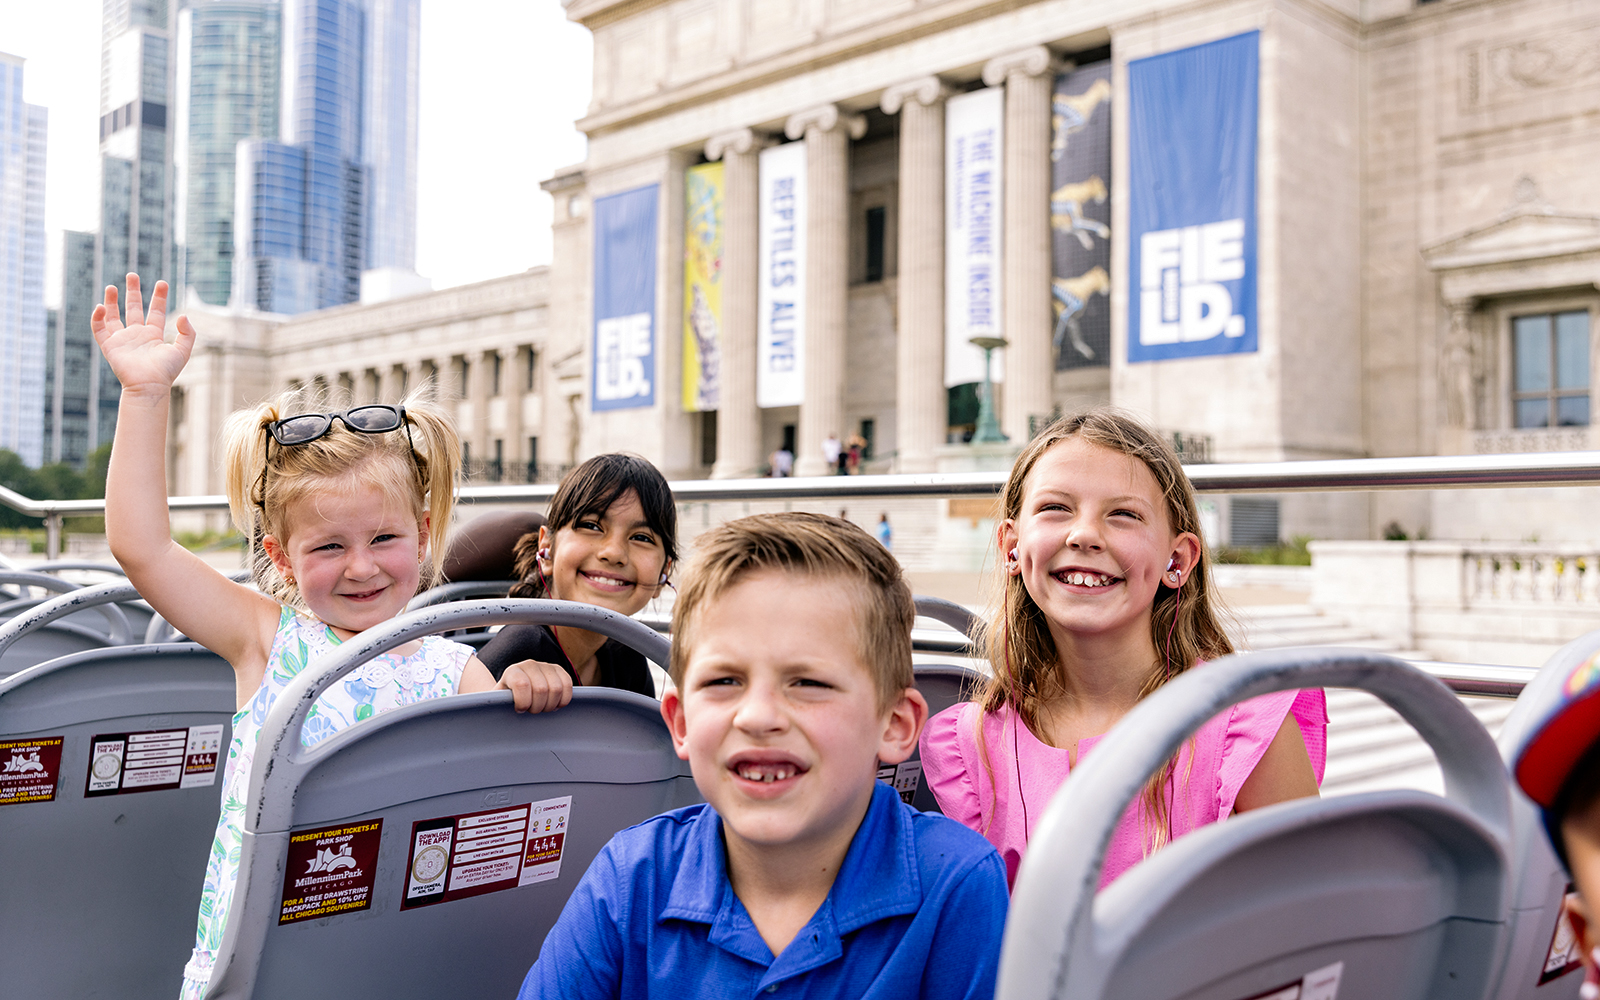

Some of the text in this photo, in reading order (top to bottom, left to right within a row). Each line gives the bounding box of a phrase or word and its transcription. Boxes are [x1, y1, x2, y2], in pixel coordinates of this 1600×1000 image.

[971, 127, 994, 161] THE
[771, 177, 795, 288] REPTILES
[18, 784, 53, 792] DRAWSTRING
[291, 832, 322, 843] PRESENT
[324, 829, 342, 837] YOUR
[343, 826, 370, 834] TICKETS
[316, 835, 353, 846] PARK SHOP
[419, 831, 450, 840] DOWNLOAD
[304, 880, 353, 892] CHICAGO
[282, 902, 321, 914] BACKPACK
[321, 898, 336, 907] AND
[338, 896, 352, 904] 10%
[283, 899, 297, 907] FOR
[305, 894, 322, 902] FREE
[324, 886, 368, 899] DRAWSTRING
[295, 908, 325, 918] CHICAGO
[326, 900, 366, 912] SOUVENIRS!
